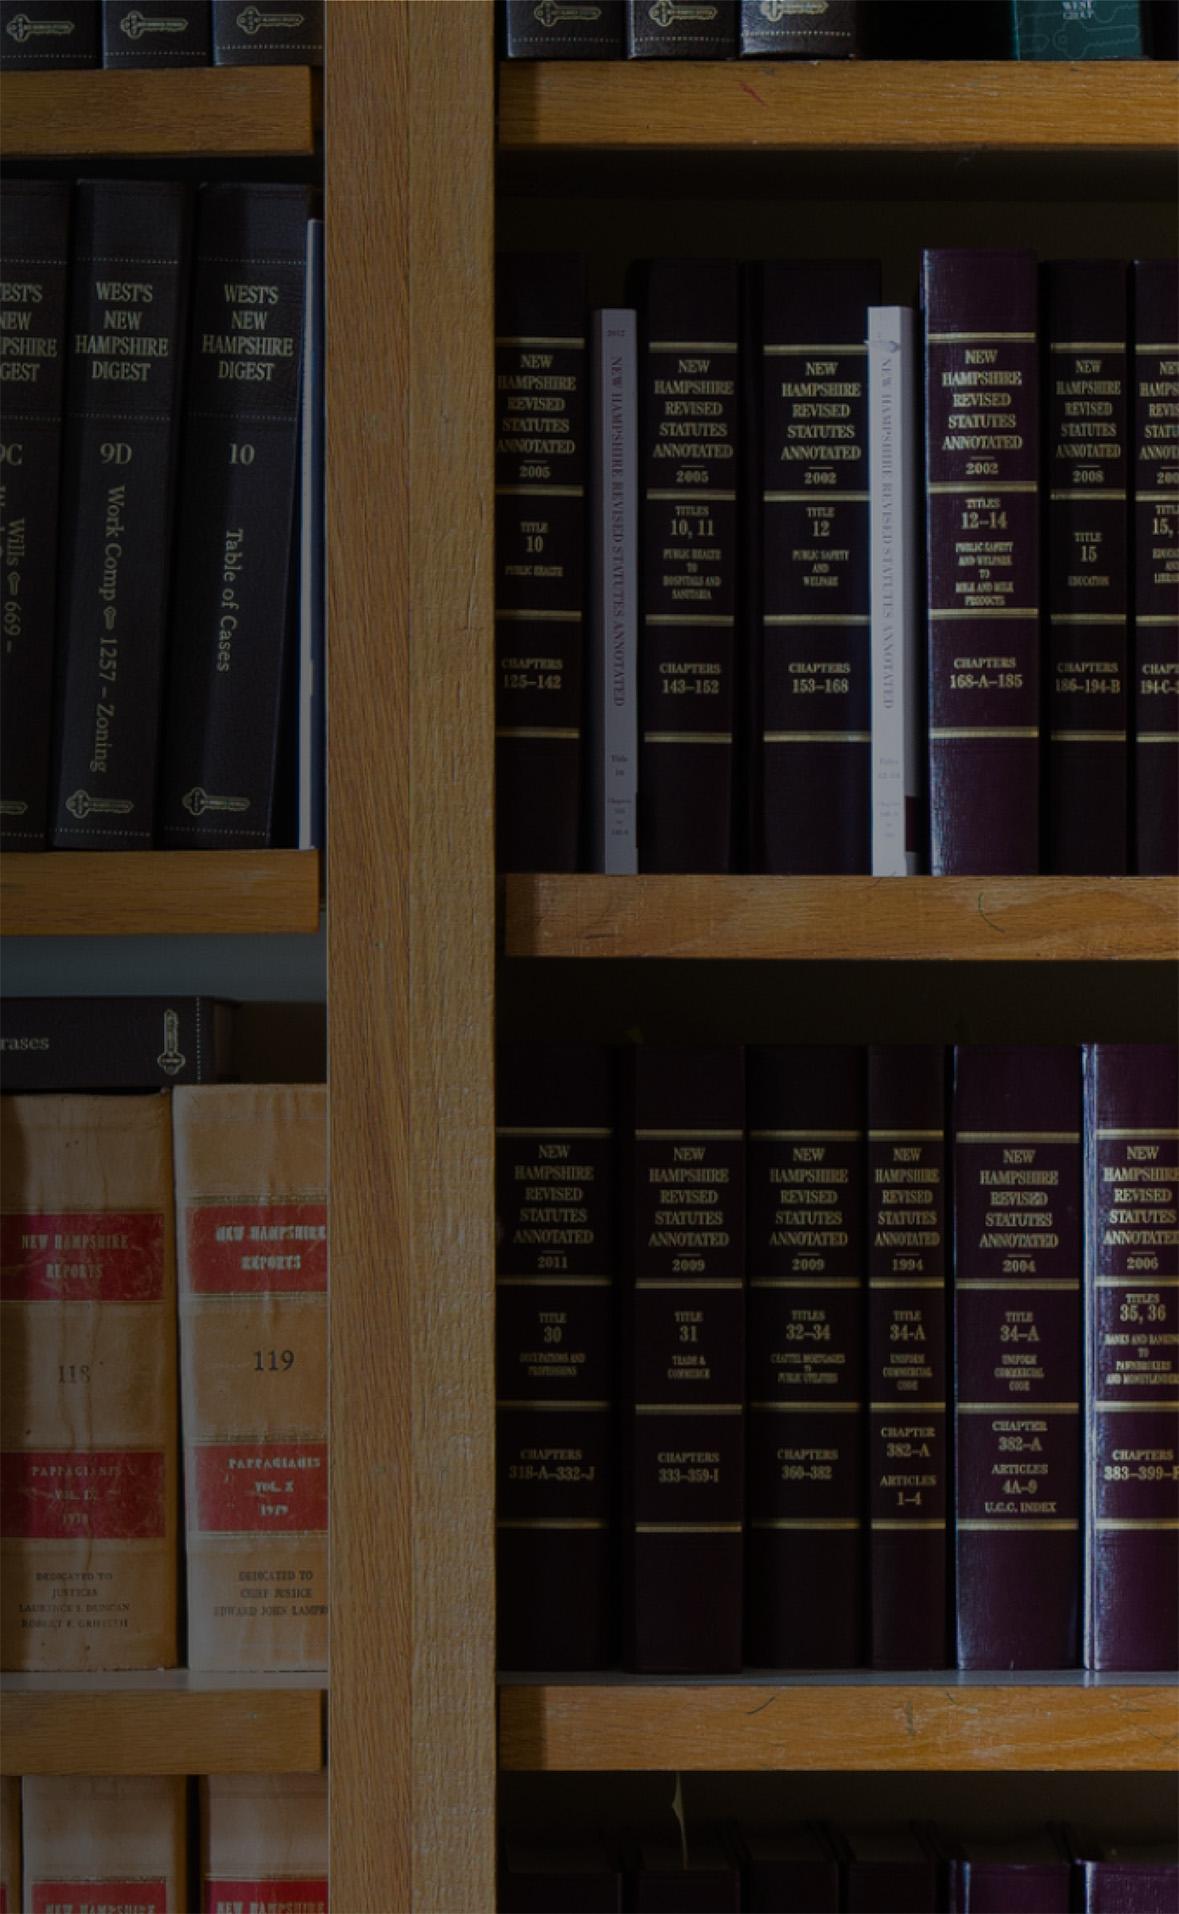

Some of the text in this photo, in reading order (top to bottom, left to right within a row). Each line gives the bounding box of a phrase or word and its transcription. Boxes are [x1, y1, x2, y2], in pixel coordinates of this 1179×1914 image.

[0, 282, 42, 303] EST'S
[96, 281, 153, 303] WEST'S
[224, 284, 280, 305] WEST'S
[103, 310, 143, 331] NEW
[231, 310, 268, 331] NEW
[74, 335, 169, 358] HAMPSHIRE
[202, 335, 294, 358] HAMPSHIRE
[520, 354, 553, 369] NEW
[964, 350, 998, 364] NEW
[0, 361, 40, 383] GEST
[92, 361, 152, 382] DIGEST
[218, 361, 275, 382] DIGEST
[677, 359, 711, 374] NEW
[805, 362, 839, 377] NEW
[1075, 360, 1102, 374] NEW
[497, 375, 577, 391] HAMPSHIRE
[941, 371, 1022, 387] HAMPSHIRE
[654, 380, 735, 396] HAMPSHIRE
[781, 382, 862, 398] HAMPSHIRE
[1056, 380, 1121, 396] HAMPSHIRE
[507, 396, 567, 412] REVISED
[952, 393, 1011, 408] REVISED
[665, 401, 723, 417] REVISED
[792, 403, 851, 419] REVISED
[1064, 401, 1113, 417] REVISED
[502, 418, 570, 433] STATUTES
[948, 413, 1017, 429] STATUTES
[659, 422, 728, 438] STATUTES
[786, 424, 855, 439] STATUTES
[1060, 422, 1117, 437] STATUTES
[497, 438, 576, 454] ANNOTATED
[653, 443, 734, 459] ANNOTATED
[941, 435, 1024, 451] ANNOTATED
[1055, 443, 1121, 459] ANNOTATED
[100, 443, 133, 466] 9D
[229, 443, 256, 466] 10
[780, 445, 862, 461] ANNOTATED
[806, 507, 836, 519] TITLE
[611, 356, 625, 708] NEW HAMPSHIRE REVISED STATUTES ANNOTATED
[670, 519, 715, 538] 10, 11
[812, 520, 831, 538] 12
[526, 535, 544, 553] 10
[1079, 545, 1097, 563] 15
[3, 518, 25, 636] Wills 669
[216, 528, 243, 672] Table of Cases
[90, 484, 126, 773] Work Comp 1257 Zoning
[501, 658, 564, 671] CHAPTERS
[659, 663, 722, 676] CHAPTERS
[788, 662, 851, 674] CHAPTERS
[953, 657, 1016, 669] CHAPTERS
[1056, 661, 1120, 674] CHAPTERS
[0, 1036, 49, 1050] rases
[538, 1145, 571, 1159] NEW
[673, 1147, 706, 1161] NEW
[792, 1147, 825, 1162] NEW
[893, 1147, 922, 1162] NEW
[1003, 1149, 1037, 1164] NEW
[1126, 1146, 1159, 1160] NEW
[514, 1165, 595, 1181] HAMPSHIRE
[649, 1168, 730, 1183] HAMPSHIRE
[769, 1168, 849, 1184] HAMPSHIRE
[874, 1168, 941, 1184] HAMPSHIRE
[979, 1170, 1059, 1185] HAMPSHIRE
[525, 1187, 584, 1202] REVISED
[659, 1189, 719, 1204] REVISED
[780, 1189, 839, 1205] REVISED
[881, 1189, 934, 1205] REVISED
[990, 1191, 1048, 1206] REVISED
[1114, 1188, 1173, 1203] REVISED
[520, 1208, 588, 1223] STATUTES
[655, 1211, 723, 1226] STATUTES
[775, 1210, 843, 1225] STATUTES
[878, 1210, 938, 1225] STATUTES
[985, 1212, 1053, 1227] STATUTES
[1109, 1209, 1177, 1224] STATUTES
[513, 1229, 595, 1245] ANNOTATED
[648, 1231, 730, 1247] ANNOTATED
[768, 1231, 849, 1247] ANNOTATED
[874, 1231, 941, 1247] ANNOTATED
[979, 1233, 1060, 1248] ANNOTATED
[1119, 1304, 1167, 1324] 35, 36
[544, 1326, 562, 1344] 30
[679, 1325, 698, 1343] 31
[253, 1350, 295, 1371] 119
[880, 1427, 936, 1438] CHAPTER
[992, 1421, 1048, 1432] CHAPTER
[520, 1449, 584, 1461] CHAPTERS
[657, 1452, 720, 1464] CHAPTERS
[777, 1449, 839, 1461] CHAPTERS
[1112, 1449, 1174, 1461] CHAPTERS
[991, 1464, 1048, 1475] ARTICLES
[879, 1475, 936, 1487] ARTICLES
[1020, 1502, 1057, 1514] INDEX
